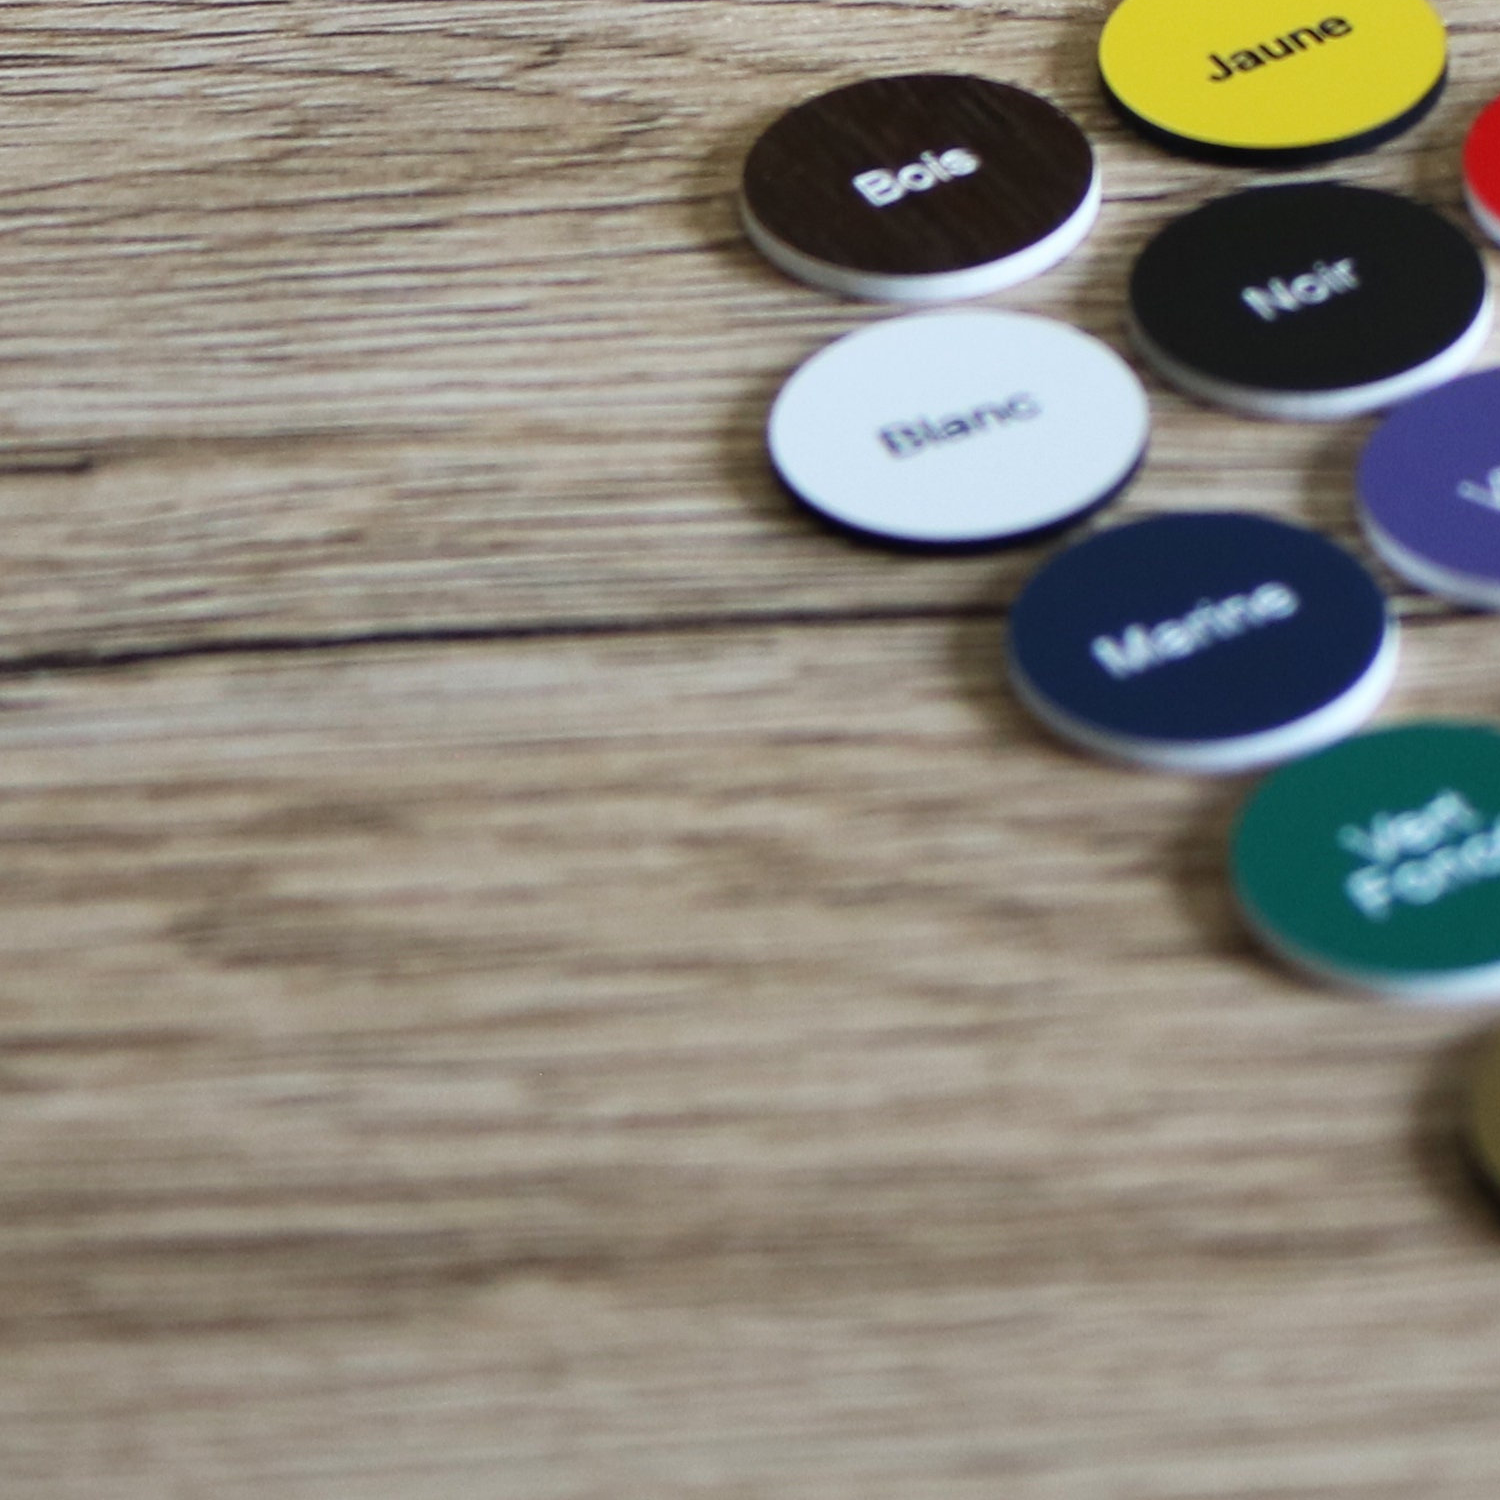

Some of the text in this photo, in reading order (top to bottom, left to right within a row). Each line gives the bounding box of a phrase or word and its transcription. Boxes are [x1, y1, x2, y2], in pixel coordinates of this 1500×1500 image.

[1208, 15, 1353, 83] Jaune
[852, 146, 980, 207] Bois
[1241, 256, 1359, 320] Noir
[877, 393, 1041, 459] Blanc
[1091, 582, 1297, 676] Marine
